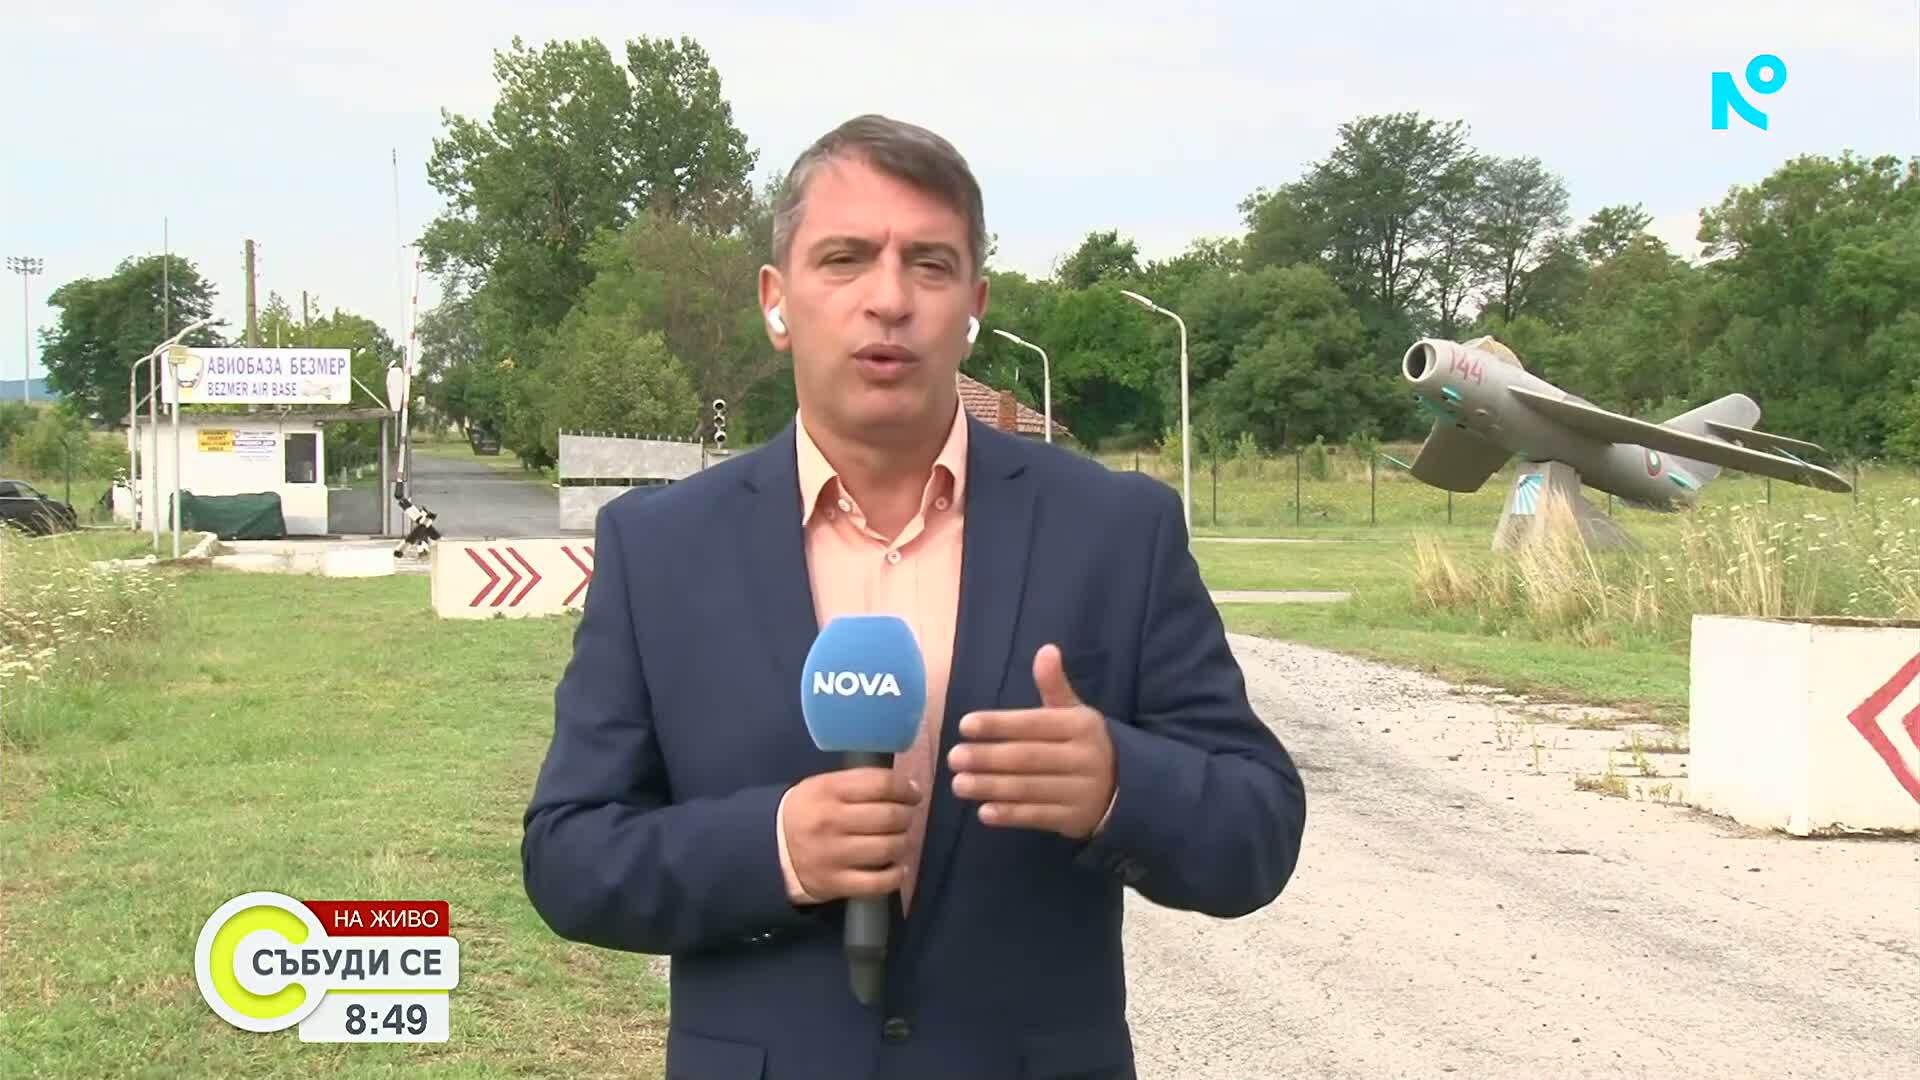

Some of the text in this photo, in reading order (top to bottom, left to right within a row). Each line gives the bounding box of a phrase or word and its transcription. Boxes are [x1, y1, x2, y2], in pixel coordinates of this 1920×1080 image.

[207, 357, 346, 375] АВИОБАЗА БЕЗМЕР
[1449, 347, 1484, 385] 144
[207, 382, 297, 396] BEZMER AIR BASE
[813, 671, 901, 696] NOVA
